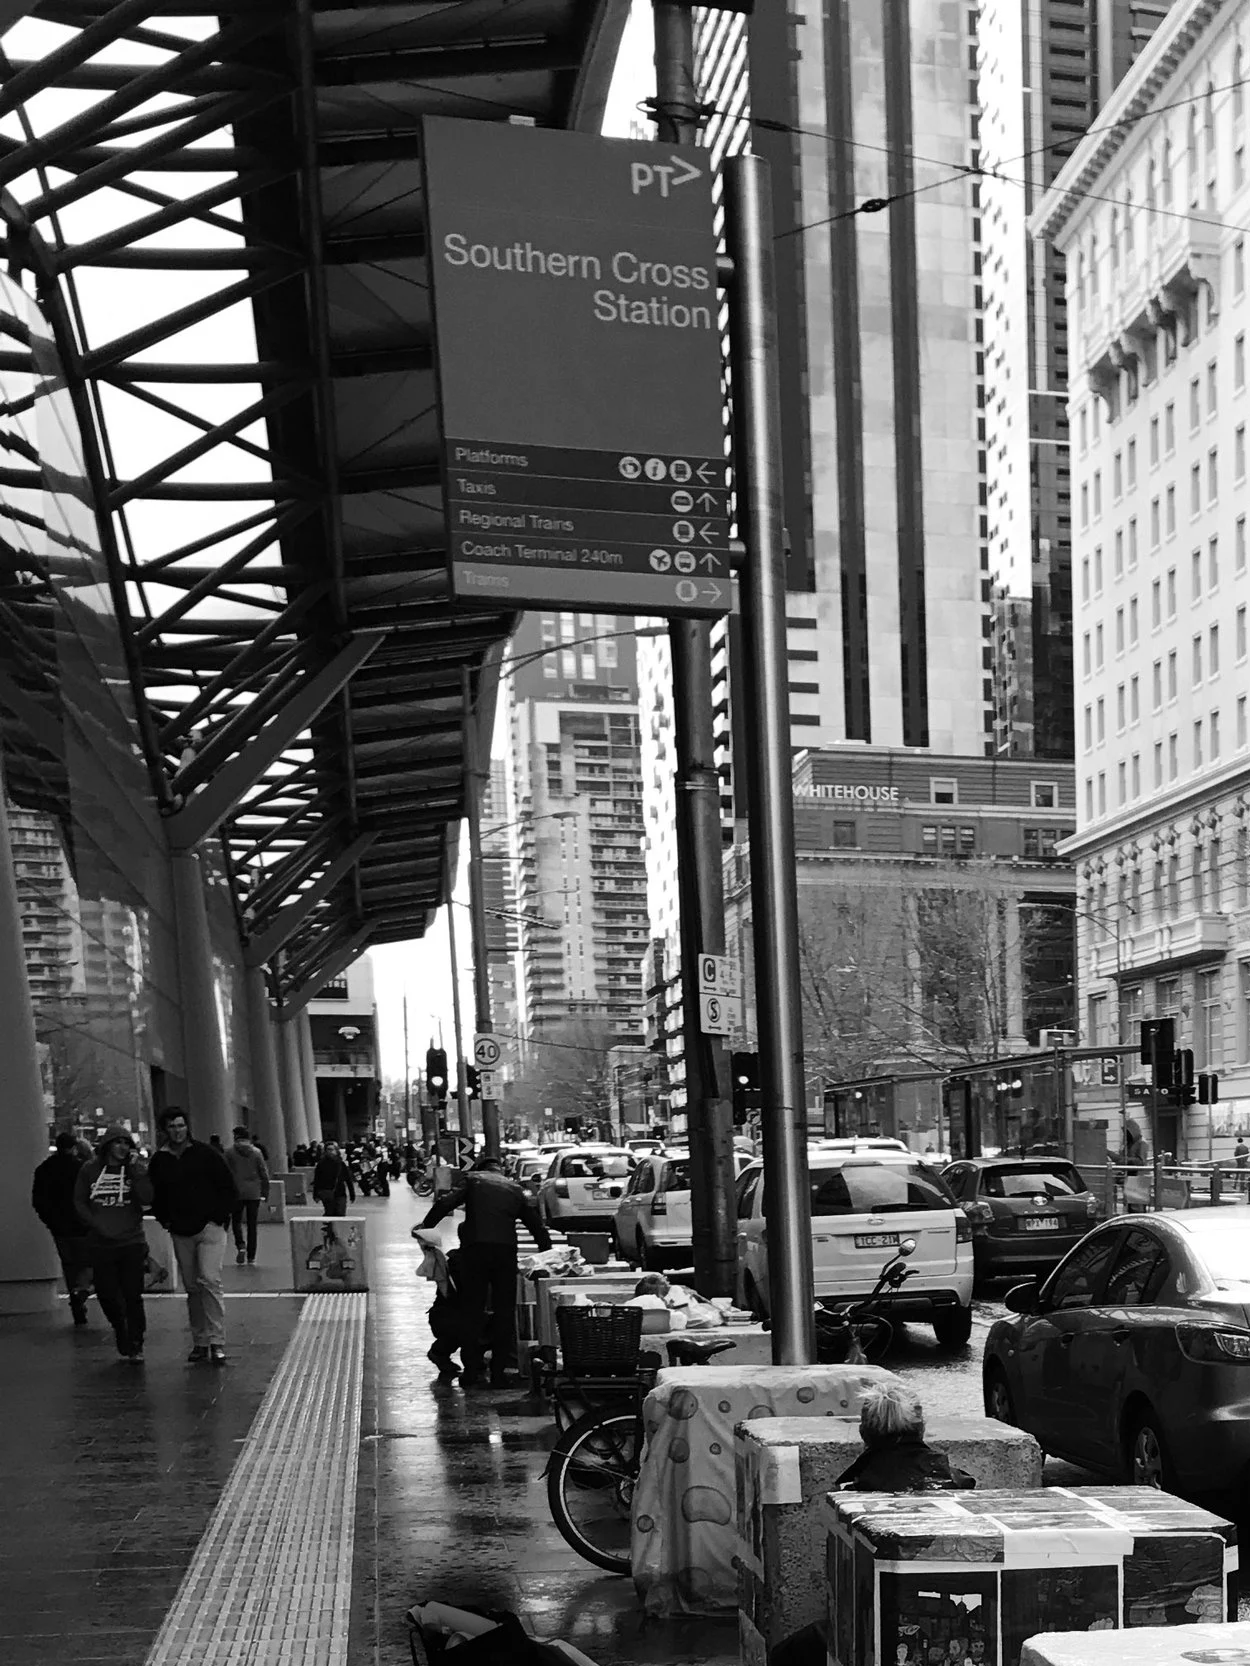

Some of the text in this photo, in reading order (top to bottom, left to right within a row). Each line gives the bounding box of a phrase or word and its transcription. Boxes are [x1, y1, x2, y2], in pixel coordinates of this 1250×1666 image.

[444, 233, 710, 289] Southern Cross
[593, 289, 711, 329] Station
[455, 447, 529, 467] Platforms
[456, 478, 497, 495] Taxis
[458, 510, 575, 532] Regional Trains
[461, 541, 624, 565] Coach Terminal 240m
[462, 571, 510, 588] Trams
[791, 784, 900, 801] WHITEHOUSE
[477, 1045, 497, 1058] 40
